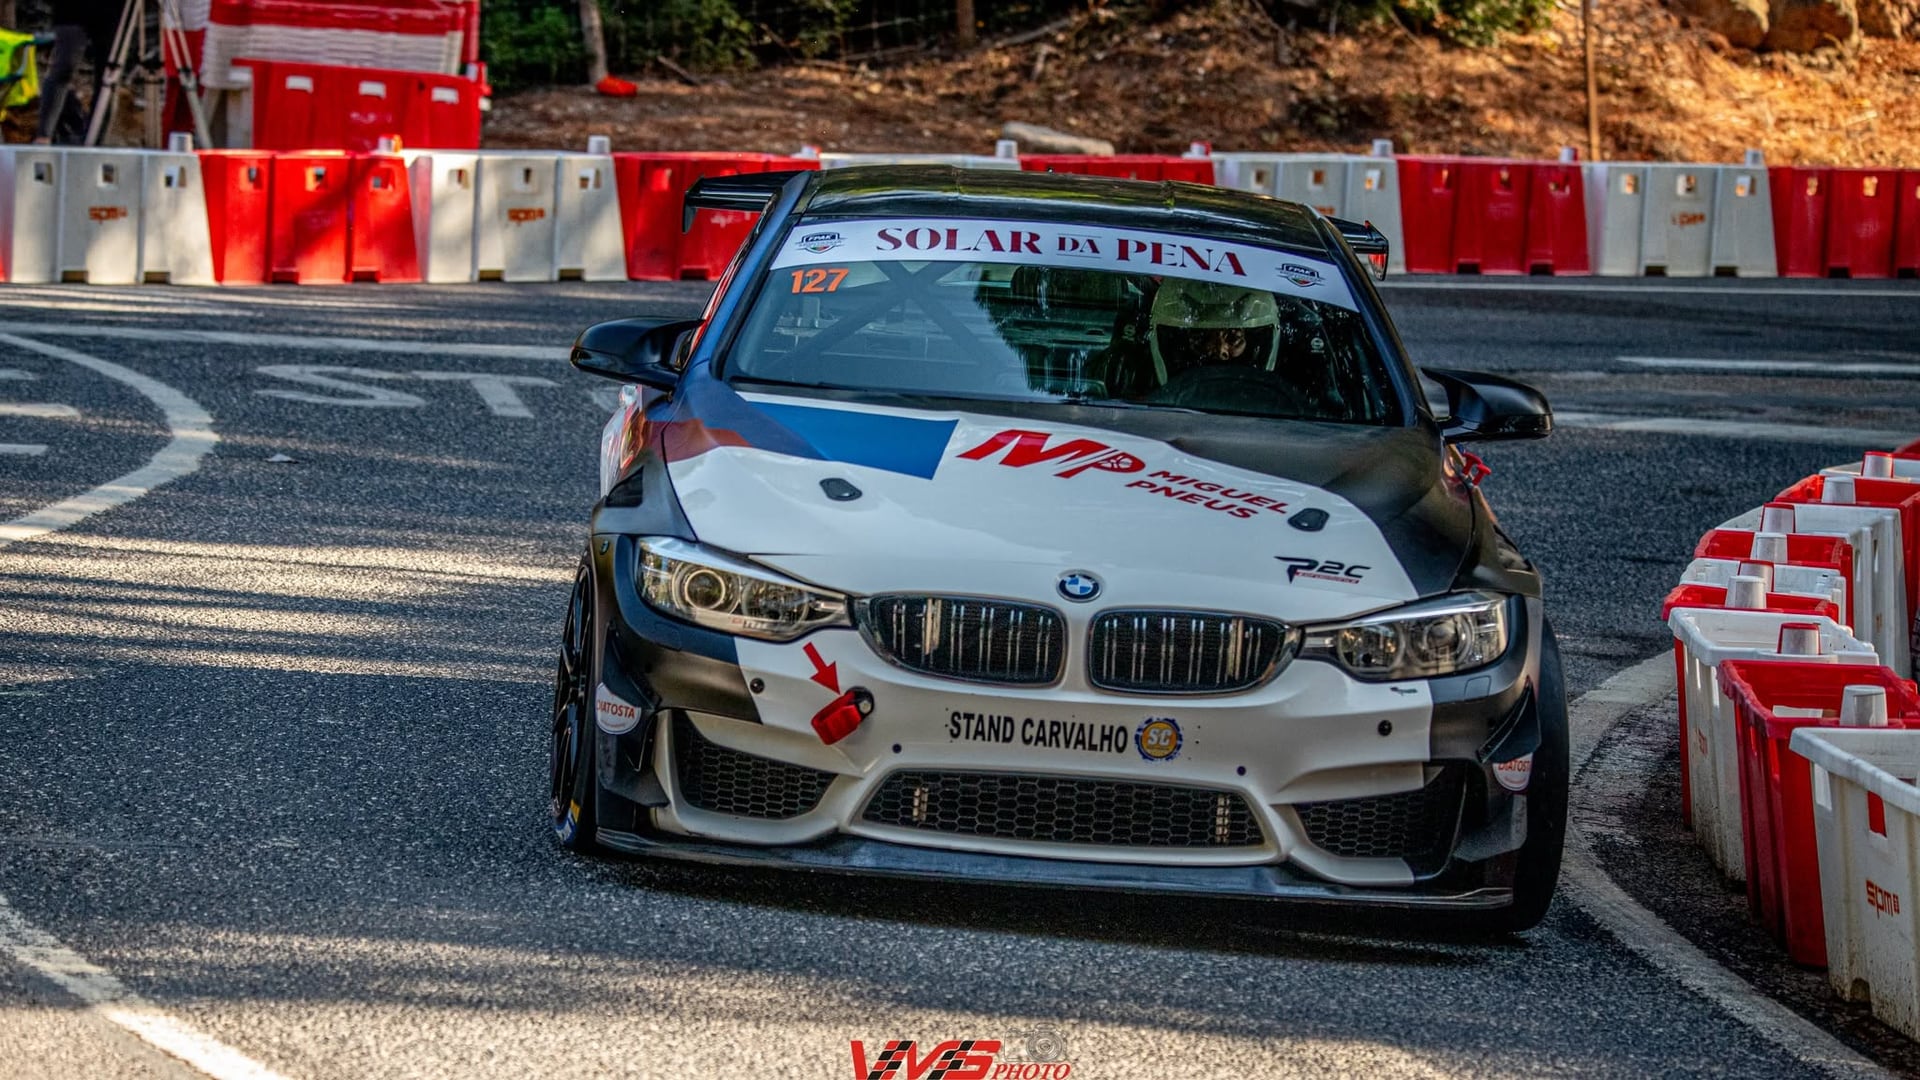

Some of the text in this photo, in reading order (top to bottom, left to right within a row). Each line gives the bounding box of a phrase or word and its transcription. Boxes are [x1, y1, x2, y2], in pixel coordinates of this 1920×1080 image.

[876, 228, 1248, 276] SOLAR DA PENA
[791, 268, 849, 294] 127
[1125, 480, 1258, 518] PNEUS
[1147, 470, 1288, 514] MIGUEL
[1273, 556, 1372, 584] P2C
[950, 711, 1129, 754] STAND CARVALHO
[1148, 728, 1173, 746] SC
